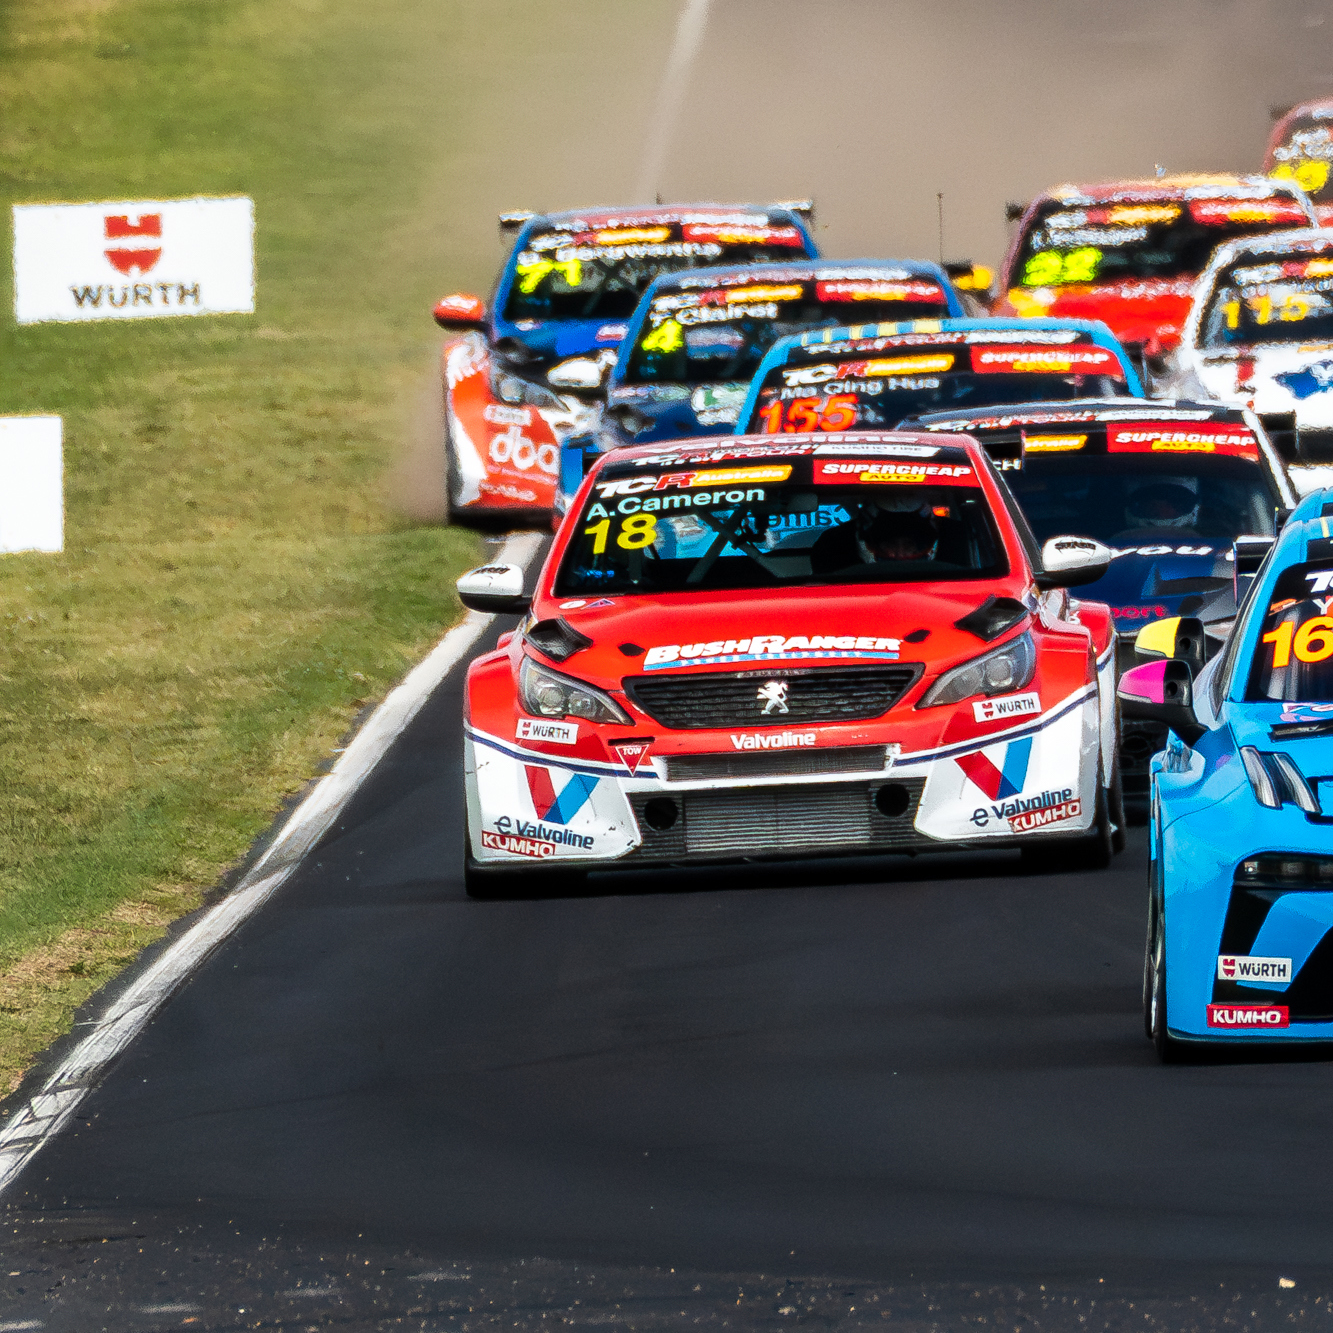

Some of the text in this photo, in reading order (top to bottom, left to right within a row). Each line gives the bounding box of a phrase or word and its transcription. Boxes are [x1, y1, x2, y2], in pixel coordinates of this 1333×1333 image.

[517, 259, 582, 294] 71
[70, 280, 201, 309] WÜRTH
[641, 319, 684, 354] 4
[759, 393, 860, 435] 155
[1114, 431, 1256, 448] SUPERCHEAP
[820, 463, 972, 478] SUPERCHEAP
[869, 472, 919, 482] AUTO
[595, 472, 697, 497] TCR
[586, 487, 766, 522] A.Cameron
[583, 511, 658, 556] 18
[995, 697, 1036, 714] WÜRTH
[532, 724, 571, 740] WÜRTH
[730, 731, 817, 751] Valvoline
[622, 746, 642, 756] TOW
[992, 787, 1073, 820] Valvoline
[1010, 800, 1081, 833] KUMHO
[483, 833, 555, 856] KUMHO
[516, 818, 595, 850] Valvoline
[1238, 961, 1288, 978] WÜRTH
[1212, 1008, 1282, 1025] KUMHO
